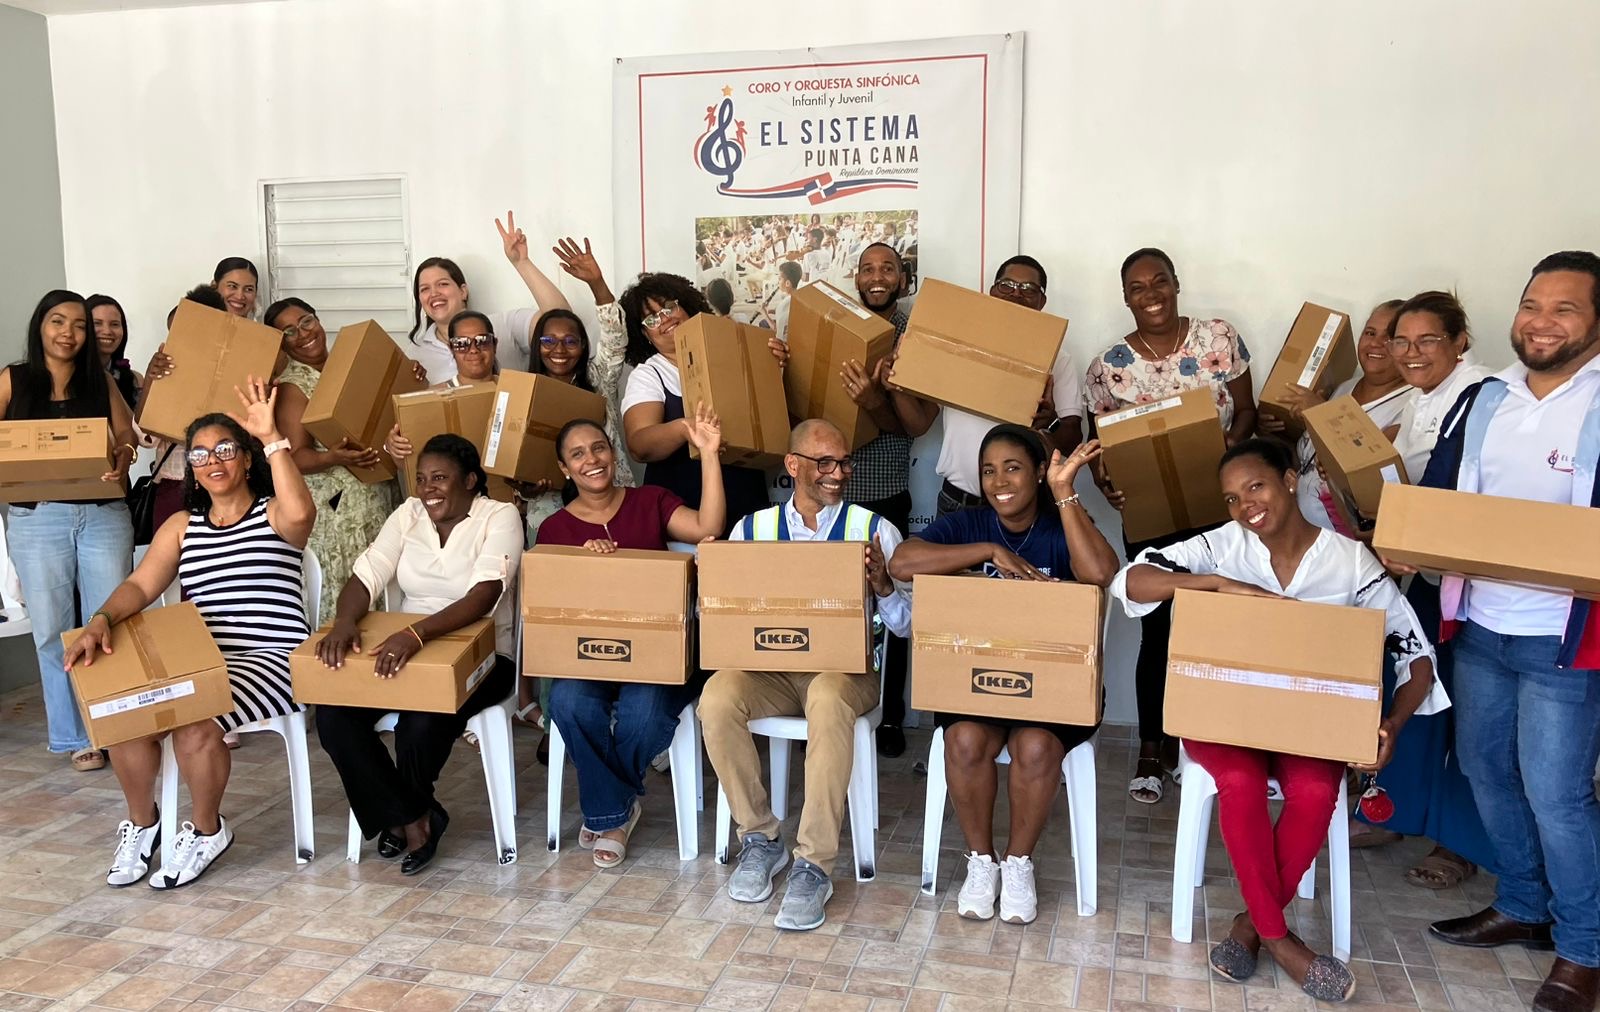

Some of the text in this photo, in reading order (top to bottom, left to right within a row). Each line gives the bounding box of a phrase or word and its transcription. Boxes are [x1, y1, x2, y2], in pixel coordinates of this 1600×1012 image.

[748, 72, 920, 94] CORO Y ORQUESTA SINFÓNICA
[792, 91, 873, 108] Infantil y Juvenil
[760, 114, 919, 146] EL SISTEMA
[804, 145, 919, 167] PUNTA CANA
[875, 166, 919, 176] Dominicana
[760, 634, 805, 644] IKEA
[583, 644, 627, 655] IKEA
[978, 676, 1028, 690] IKEA
